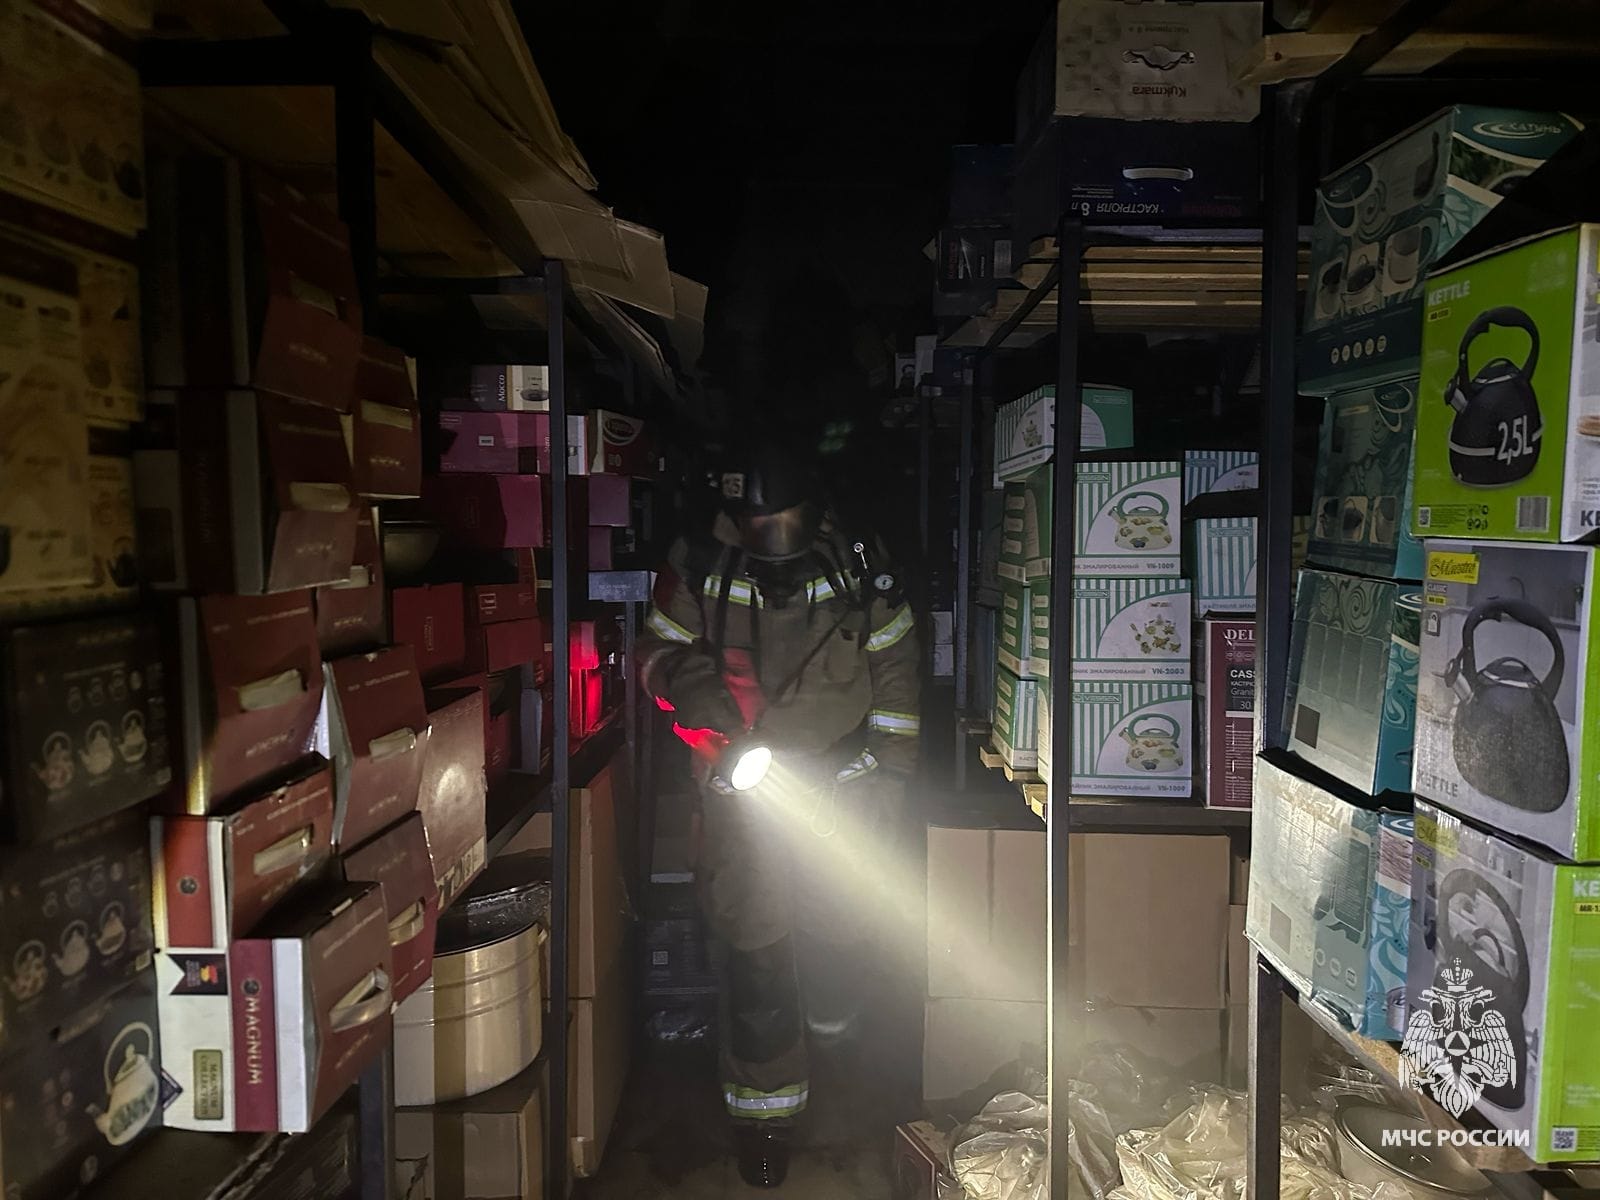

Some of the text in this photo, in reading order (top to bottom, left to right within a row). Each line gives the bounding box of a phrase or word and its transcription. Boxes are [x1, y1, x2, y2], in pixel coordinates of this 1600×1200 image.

[1132, 86, 1187, 97] Kukmara
[1080, 201, 1090, 216] 8
[1096, 201, 1160, 213] КАСТРЮЛЯ
[1428, 280, 1470, 306] KETTLE
[1417, 768, 1458, 797] KETTLE
[246, 997, 262, 1085] MAGNUM
[200, 1055, 208, 1115] COLLECTION
